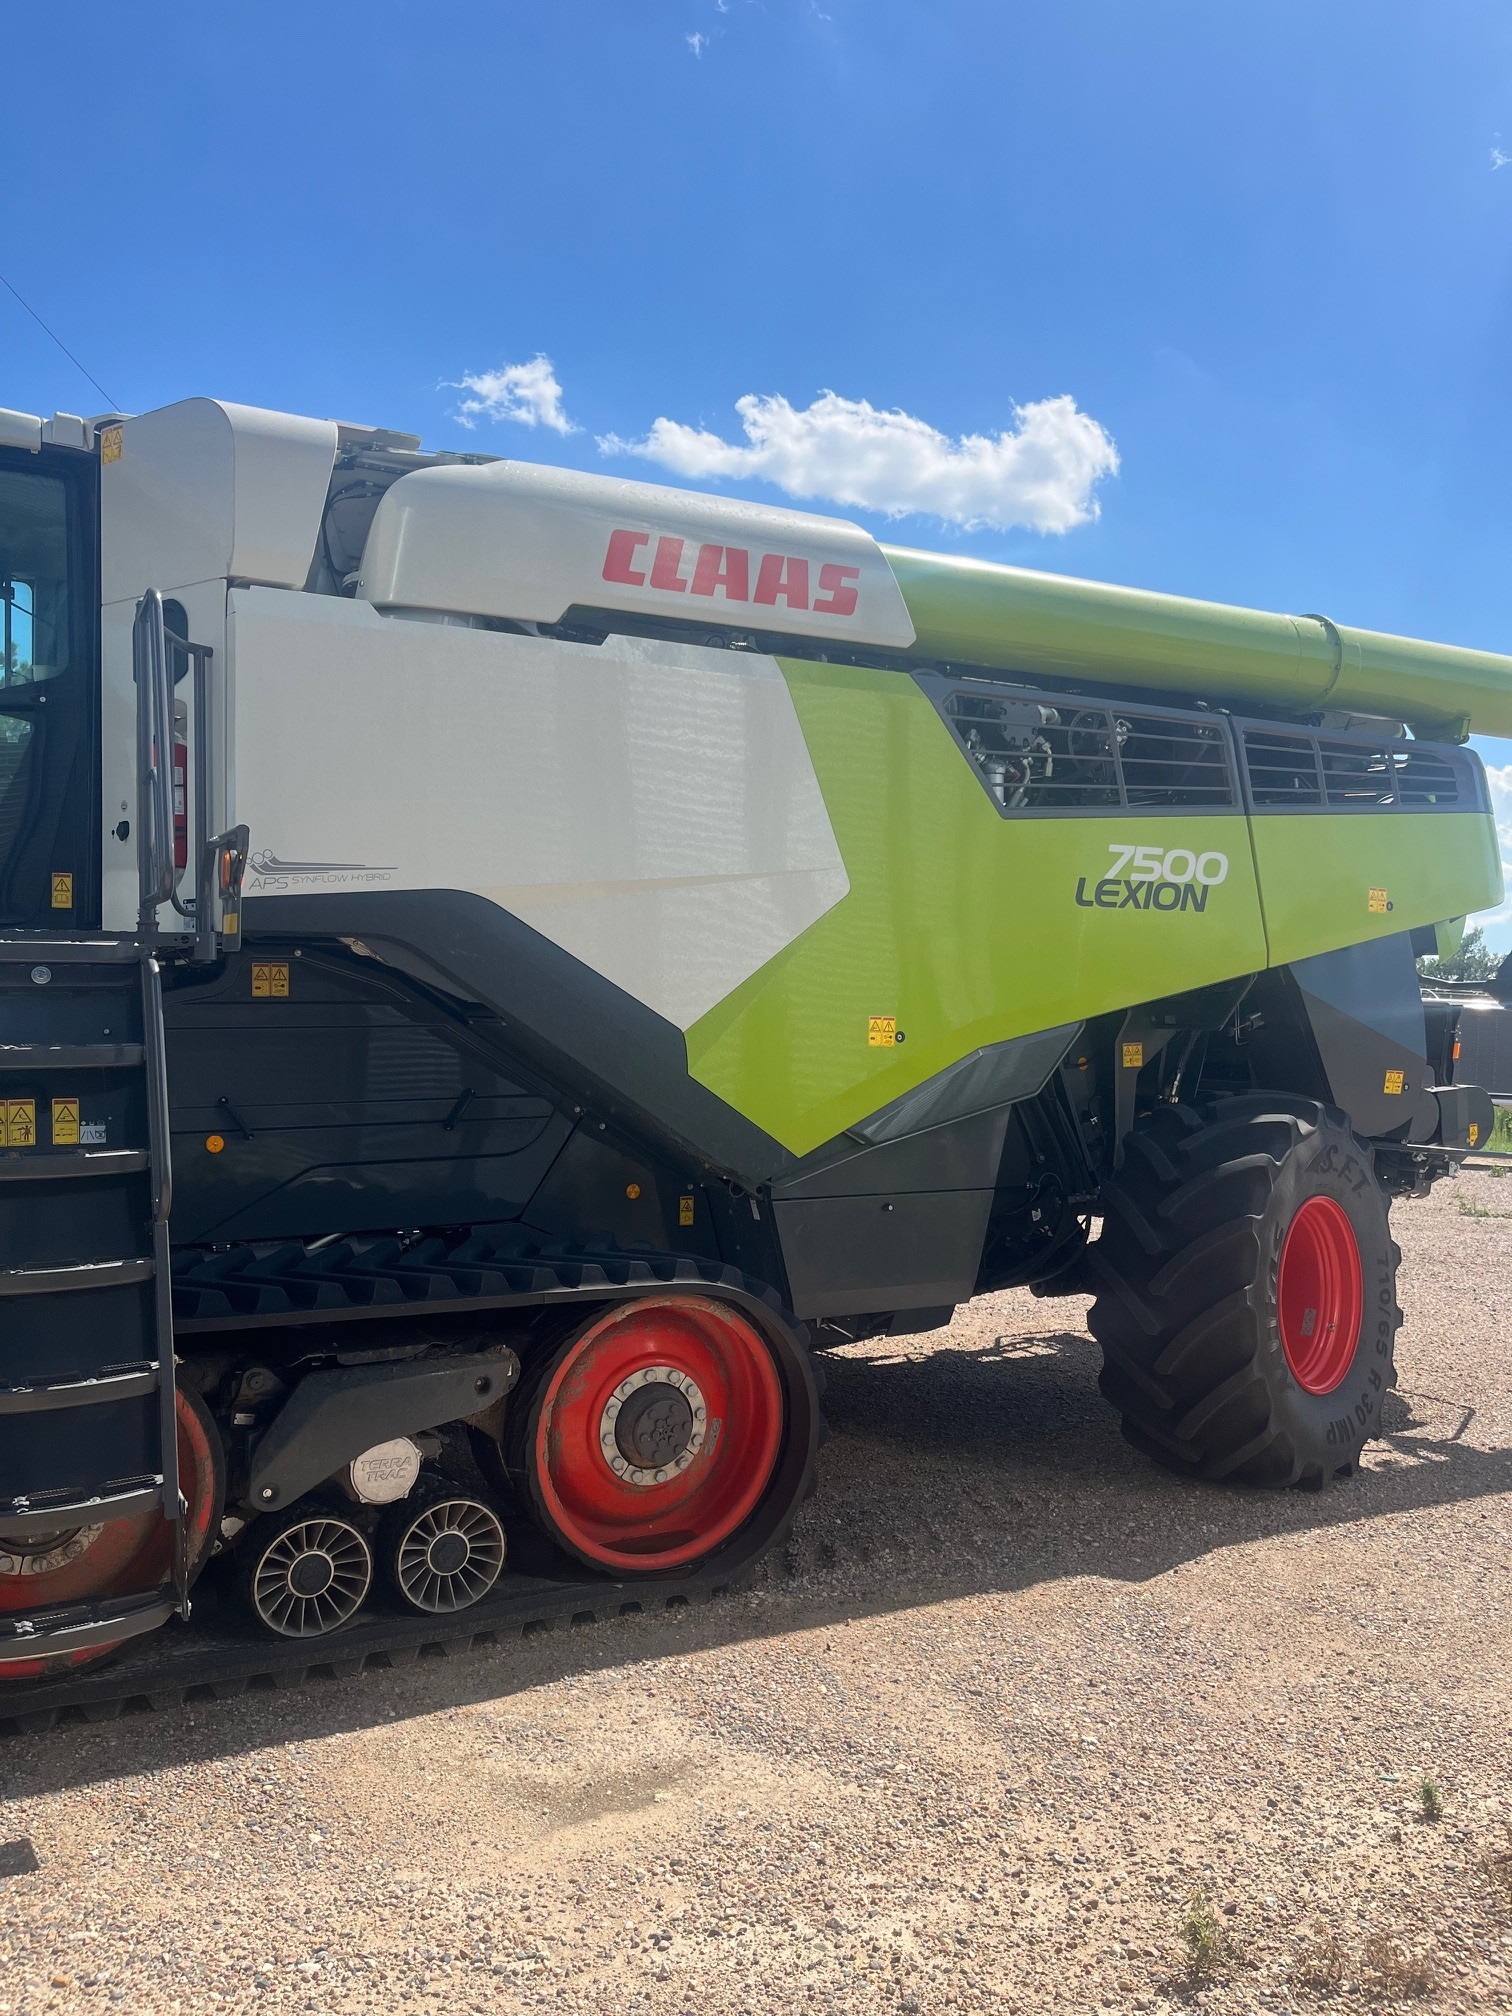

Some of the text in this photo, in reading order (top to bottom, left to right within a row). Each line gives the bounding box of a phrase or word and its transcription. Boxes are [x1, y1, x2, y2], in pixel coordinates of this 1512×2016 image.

[602, 529, 861, 616] CLAAS
[248, 872, 391, 891] APS SYNFLOW HYBRID
[1104, 844, 1229, 886] 7500
[1075, 877, 1209, 913] LEXION
[1376, 1250, 1391, 1359] 710/65
[1367, 1368, 1382, 1392] R
[1354, 1393, 1373, 1427] 30
[361, 1456, 412, 1471] TERRA
[366, 1467, 408, 1482] TRAC
